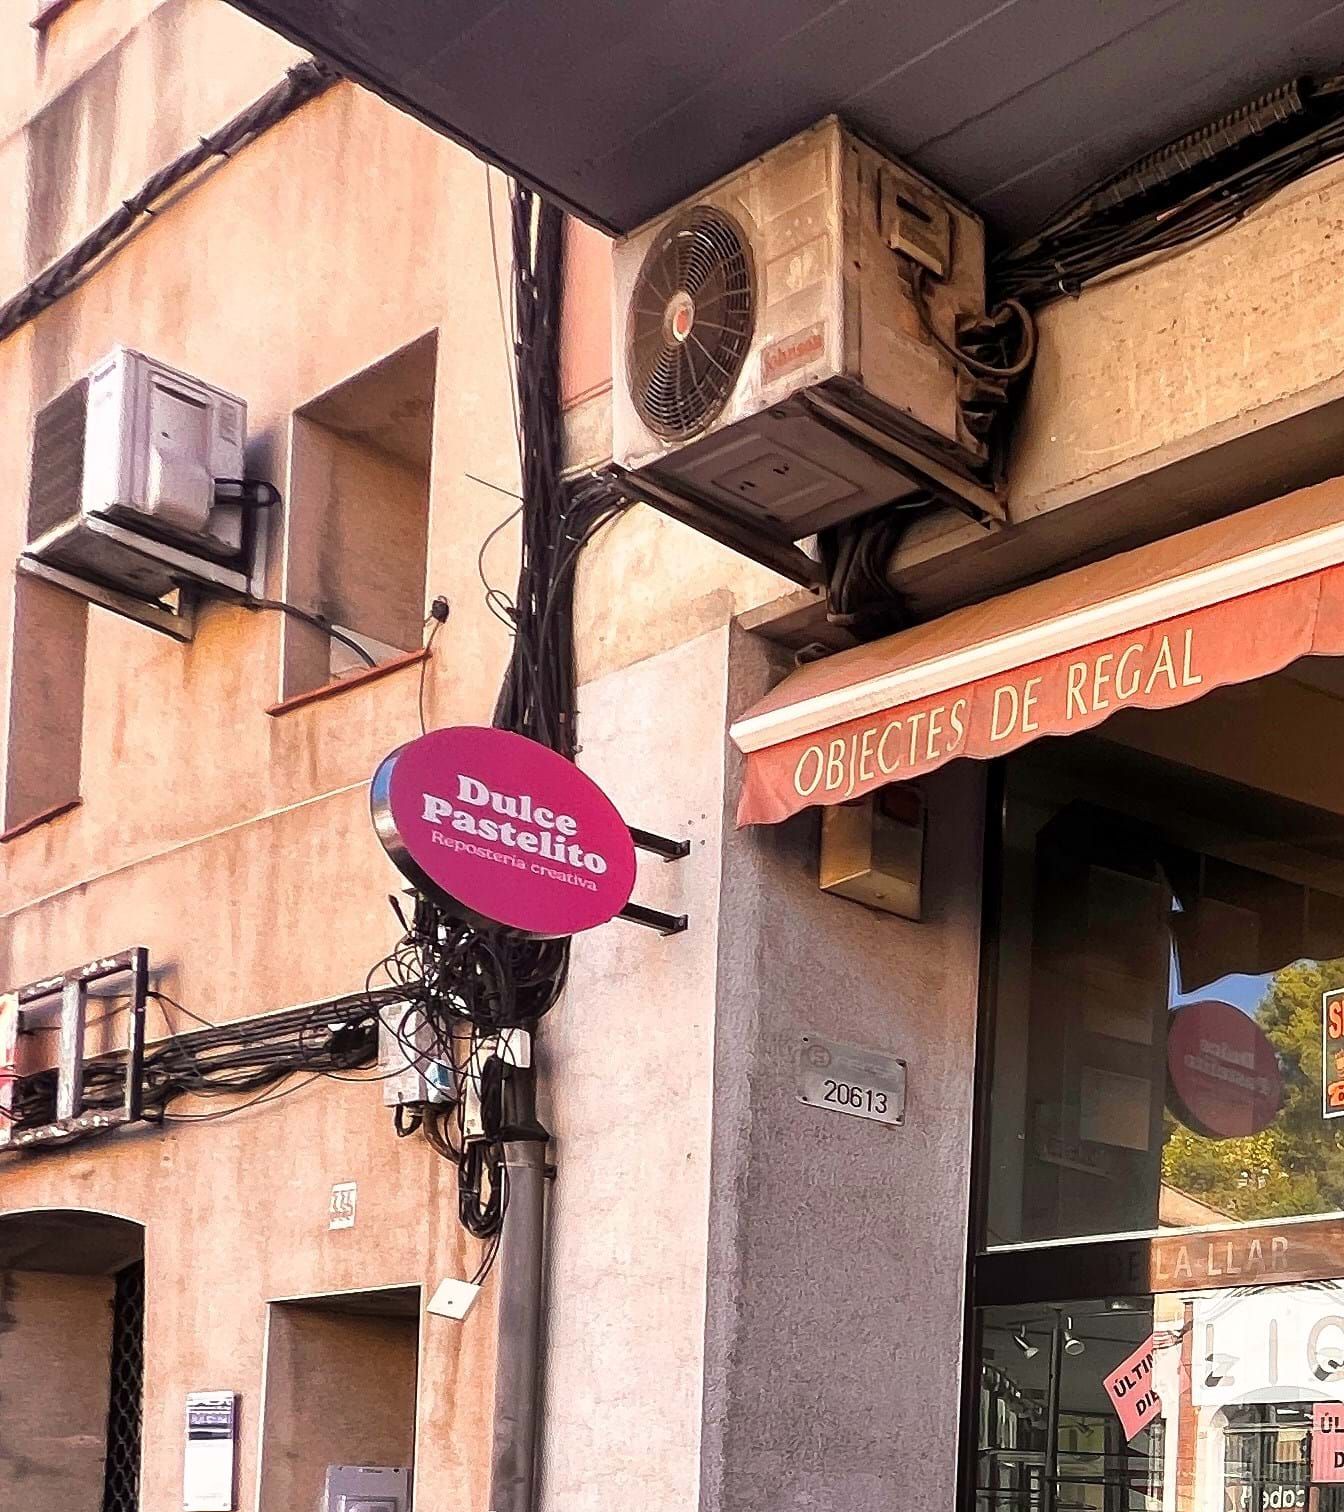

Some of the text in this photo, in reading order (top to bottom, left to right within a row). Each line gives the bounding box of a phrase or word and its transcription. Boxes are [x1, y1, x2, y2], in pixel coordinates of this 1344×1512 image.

[793, 628, 1202, 798] OBJECTES DE REGAL
[456, 774, 578, 837] Dulce
[421, 793, 608, 875] Pastelito
[530, 863, 599, 892] creativa
[823, 1080, 888, 1113] 20613
[1206, 1237, 1289, 1277] LLAR
